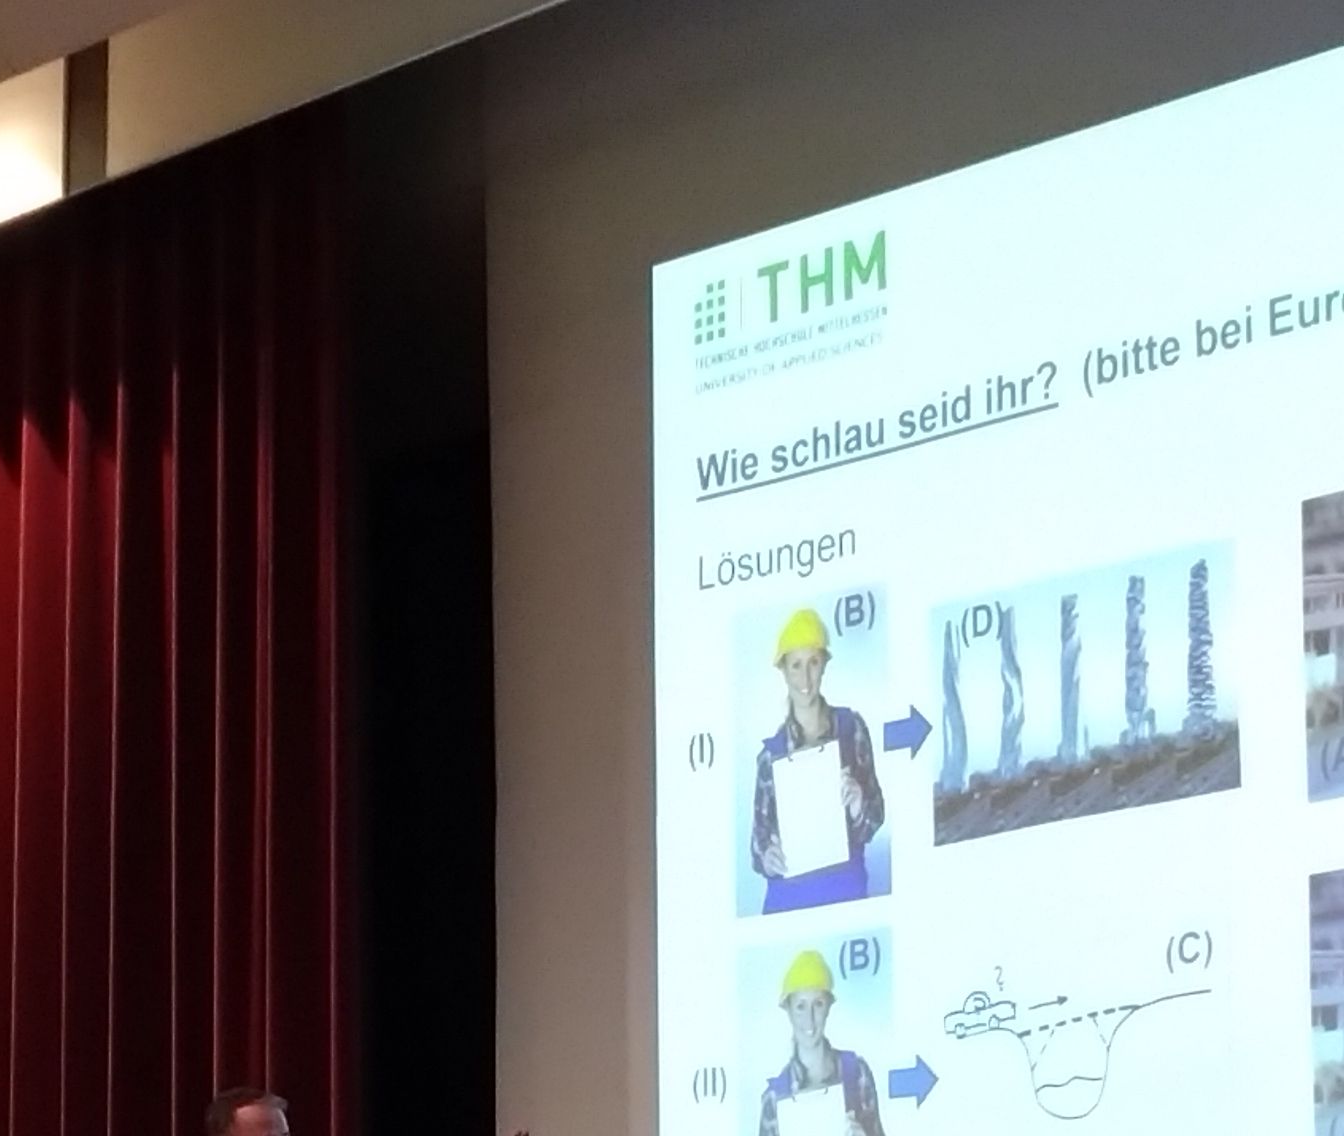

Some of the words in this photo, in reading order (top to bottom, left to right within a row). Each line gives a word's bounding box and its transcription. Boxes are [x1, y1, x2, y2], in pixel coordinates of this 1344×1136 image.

[757, 230, 888, 322] THM
[696, 448, 758, 491] Wie
[770, 415, 886, 474] schlau
[897, 385, 972, 441] seid
[985, 360, 1059, 418] ihr?
[1082, 330, 1182, 398] (bitte
[1195, 305, 1255, 357] bei
[696, 526, 857, 591] Lösungen
[833, 589, 877, 637] (B)
[960, 601, 1003, 647] (D)
[688, 733, 716, 772] (I)
[838, 936, 882, 980] (B)
[1165, 930, 1214, 973] (C)
[692, 1066, 728, 1104] (II)
